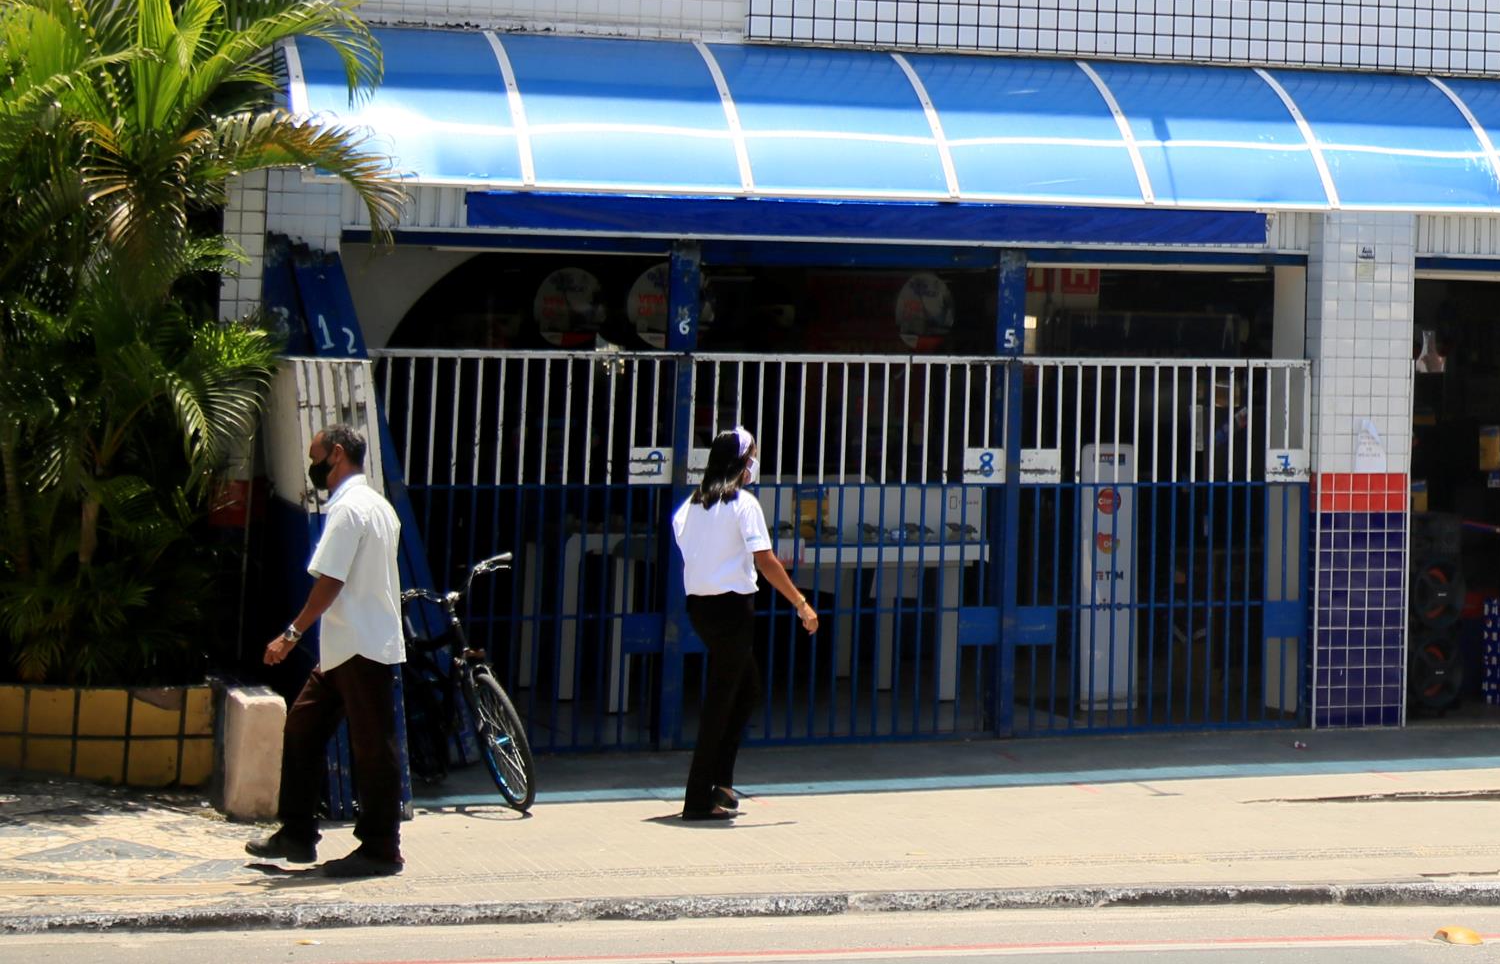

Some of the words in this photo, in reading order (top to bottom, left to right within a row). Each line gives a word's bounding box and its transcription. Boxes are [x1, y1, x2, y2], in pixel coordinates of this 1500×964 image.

[679, 318, 691, 335] 6
[1003, 328, 1016, 348] 5
[979, 452, 994, 477] 8
